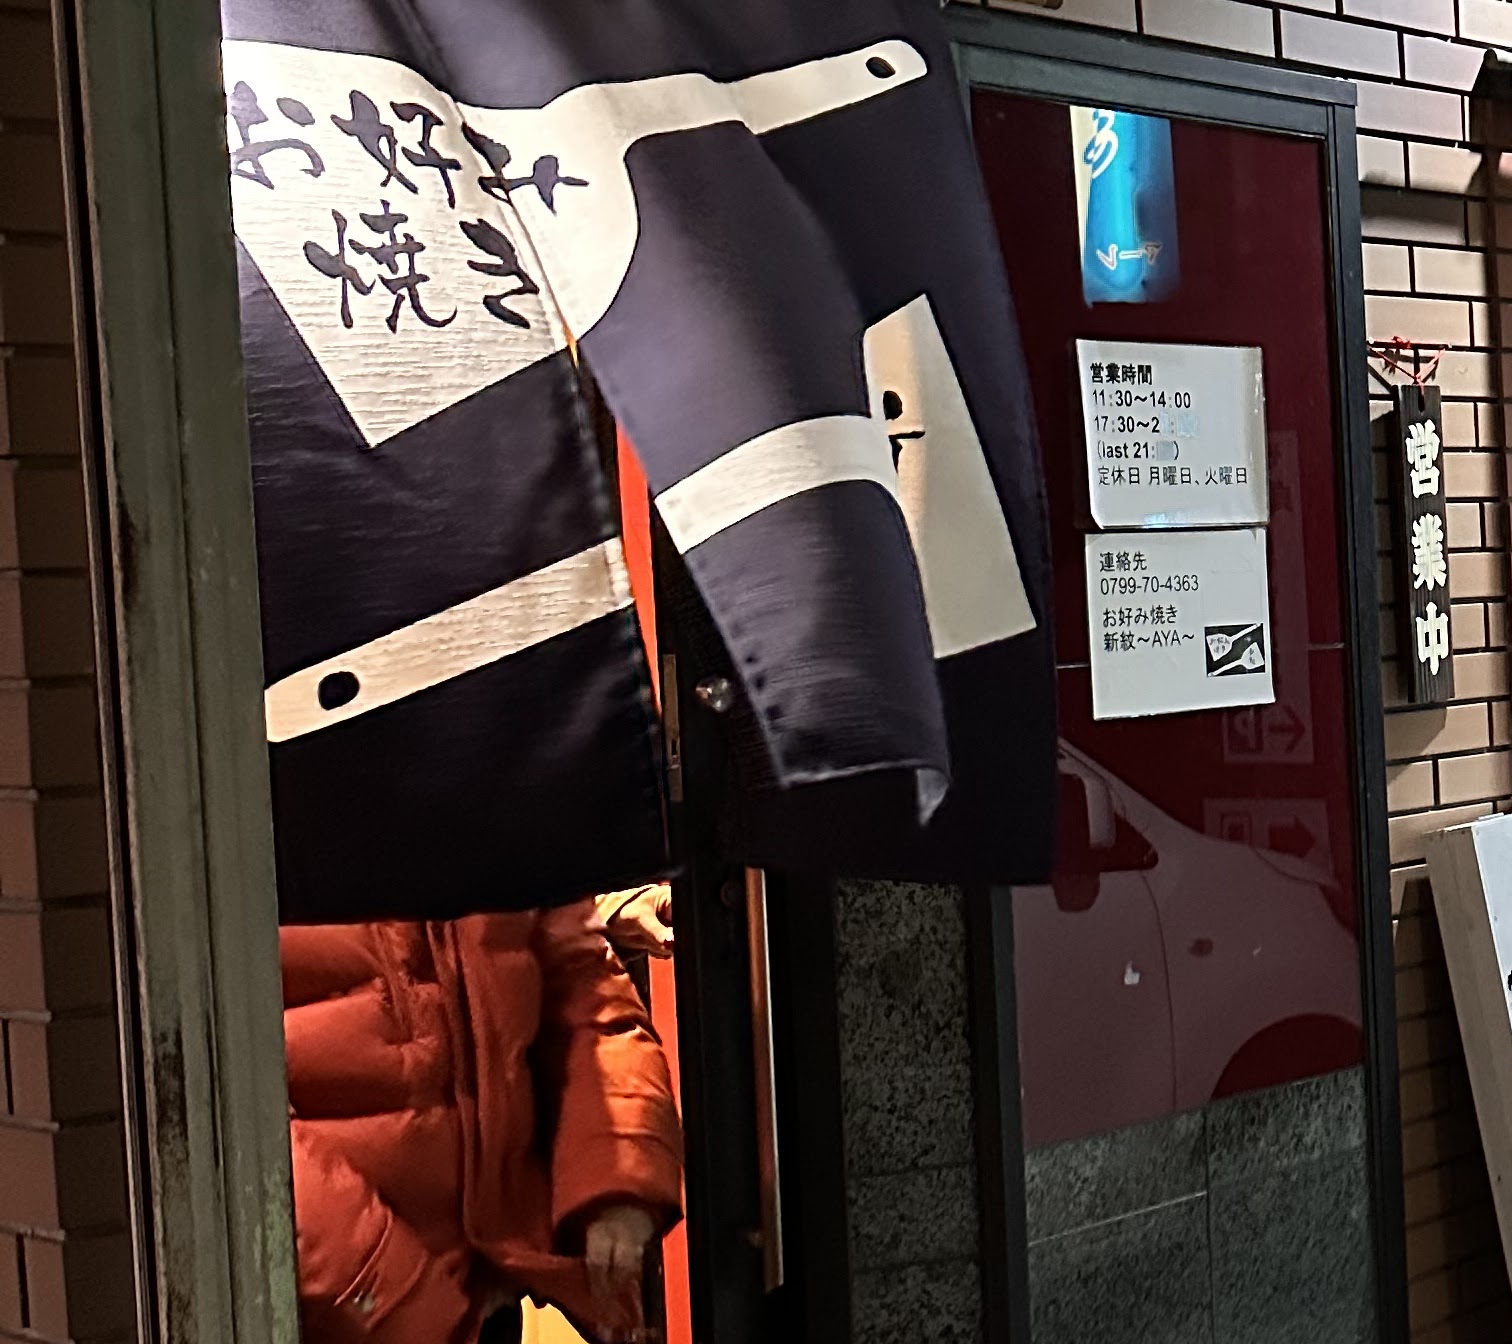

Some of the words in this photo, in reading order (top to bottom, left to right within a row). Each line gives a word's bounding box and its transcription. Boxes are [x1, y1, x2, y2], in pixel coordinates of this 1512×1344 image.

[229, 81, 589, 213] お好み
[303, 199, 539, 333] 焼き
[1090, 362, 1152, 385] 営業時間
[1098, 441, 1128, 459] (last
[1133, 441, 1179, 461] 21:)
[1098, 465, 1140, 485] 定休日
[1148, 465, 1248, 485] 月曜日、火曜日
[1405, 418, 1450, 676] 営業中
[1099, 551, 1148, 572] 連絡先
[1100, 574, 1199, 595] 0799-70-4363
[1103, 604, 1178, 628] お好み焼き
